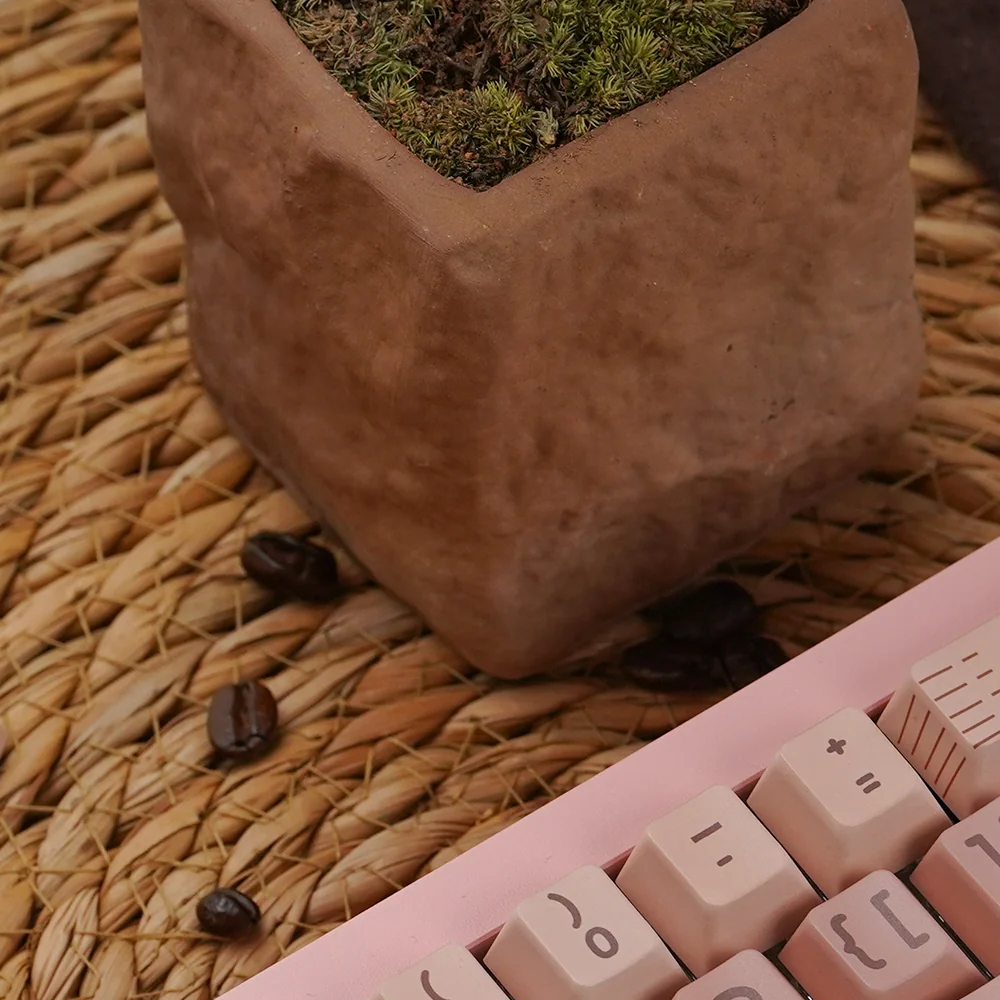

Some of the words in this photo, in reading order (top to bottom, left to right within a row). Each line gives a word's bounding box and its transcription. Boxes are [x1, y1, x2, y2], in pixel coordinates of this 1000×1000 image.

[826, 738, 847, 756] +
[547, 893, 582, 929] )
[829, 913, 887, 970] {
[870, 889, 930, 949] [
